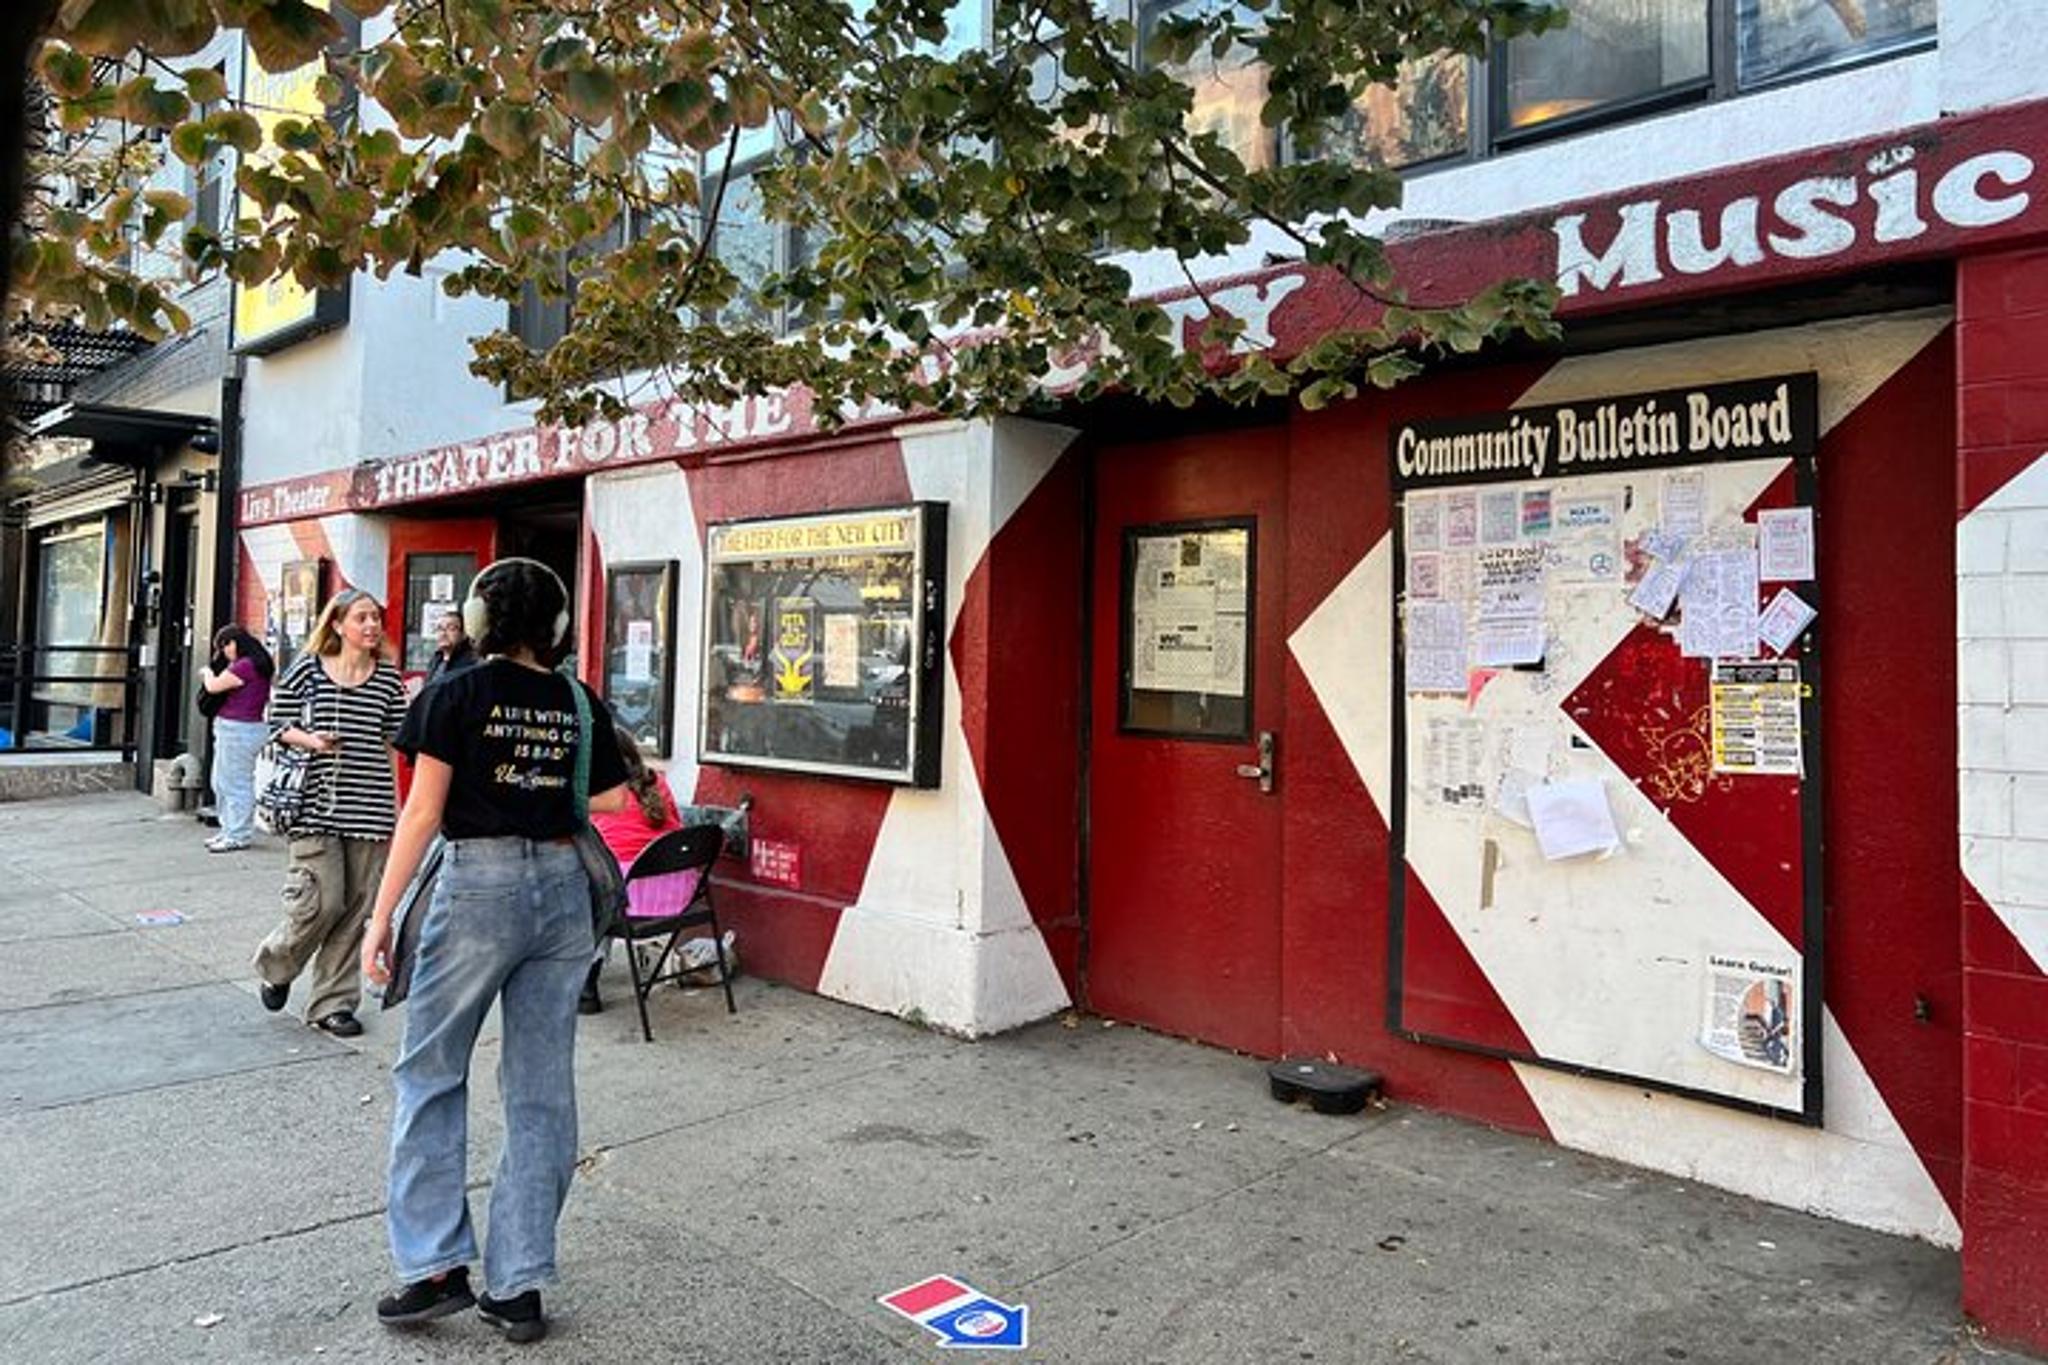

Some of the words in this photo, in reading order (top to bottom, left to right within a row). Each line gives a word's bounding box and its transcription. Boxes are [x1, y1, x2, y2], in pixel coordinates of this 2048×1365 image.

[1398, 416, 1551, 478] Community
[1557, 400, 1679, 464] Bulletin
[1687, 383, 1792, 452] Board
[376, 436, 544, 501] THEATER
[555, 409, 654, 469] FOR
[274, 484, 330, 514] Theater
[806, 526, 833, 546] THE
[836, 523, 866, 544] NEW
[872, 519, 910, 543] CITY
[490, 704, 502, 718] A
